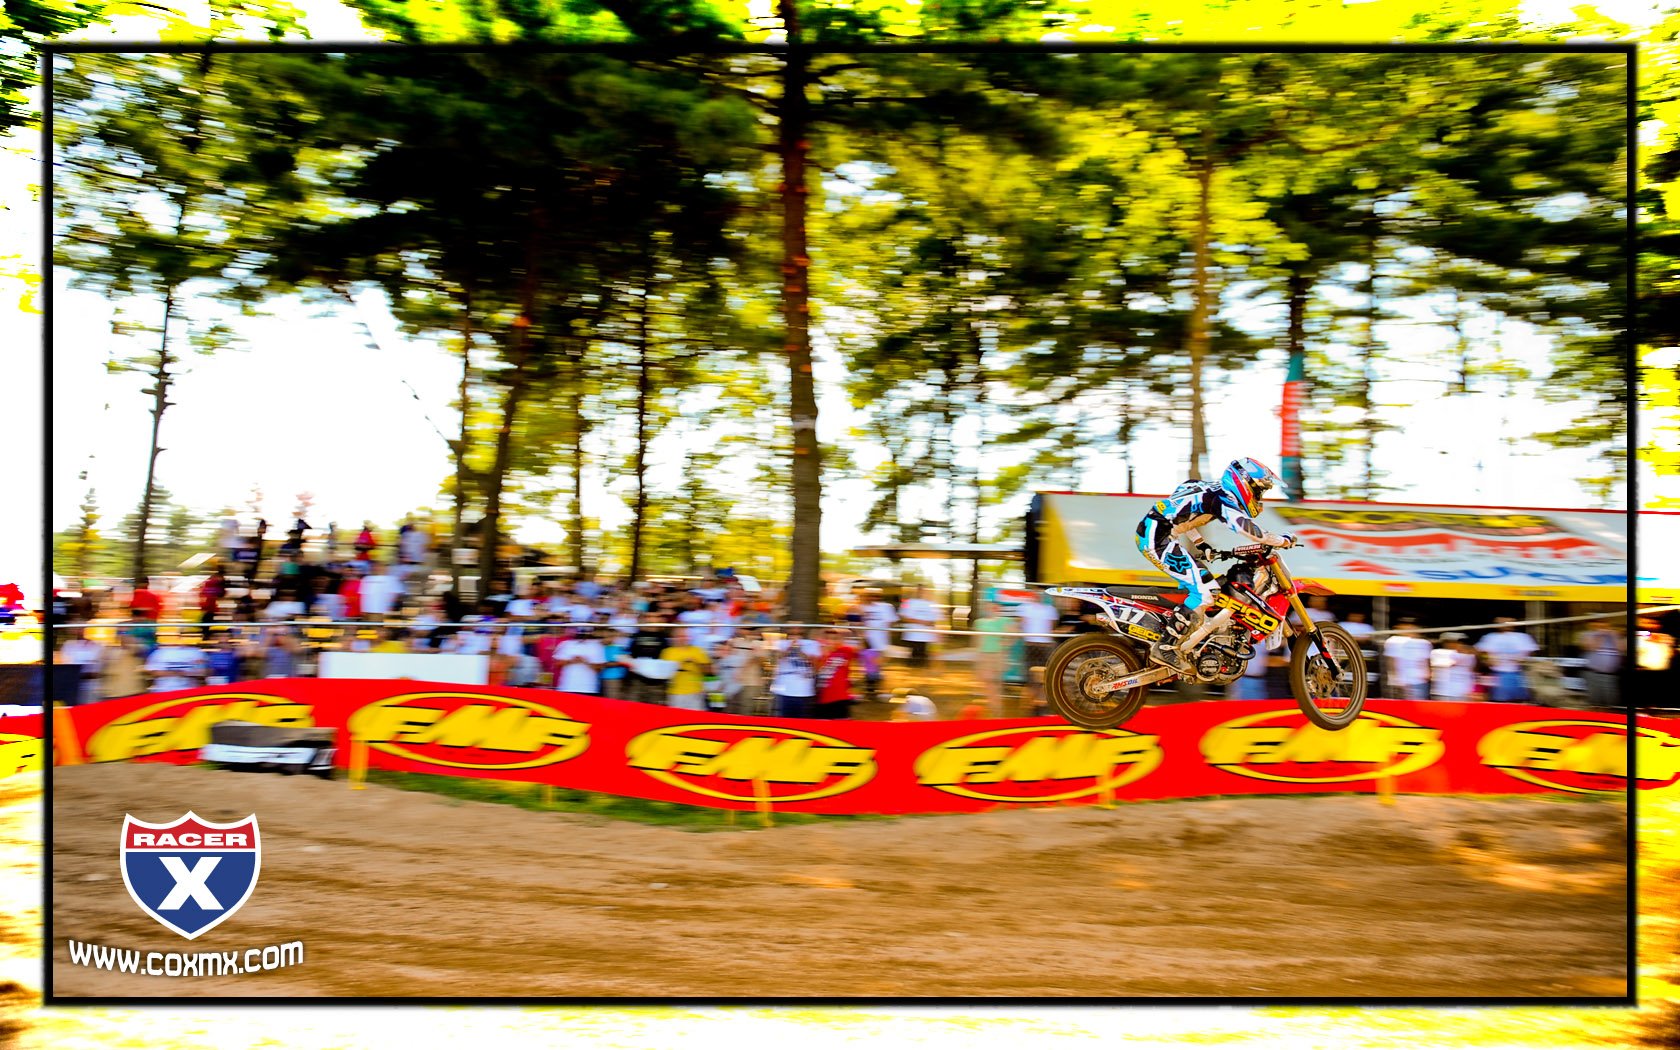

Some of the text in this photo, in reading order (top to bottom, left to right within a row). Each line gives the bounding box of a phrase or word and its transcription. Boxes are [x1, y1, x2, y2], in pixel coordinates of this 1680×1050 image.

[1119, 607, 1146, 625] 17
[1128, 624, 1161, 641] GEICO
[1214, 592, 1279, 632] GEICO
[351, 705, 593, 753] FMF
[1203, 718, 1442, 766] FMF
[627, 733, 878, 785] FMF
[916, 733, 1162, 786] FMF
